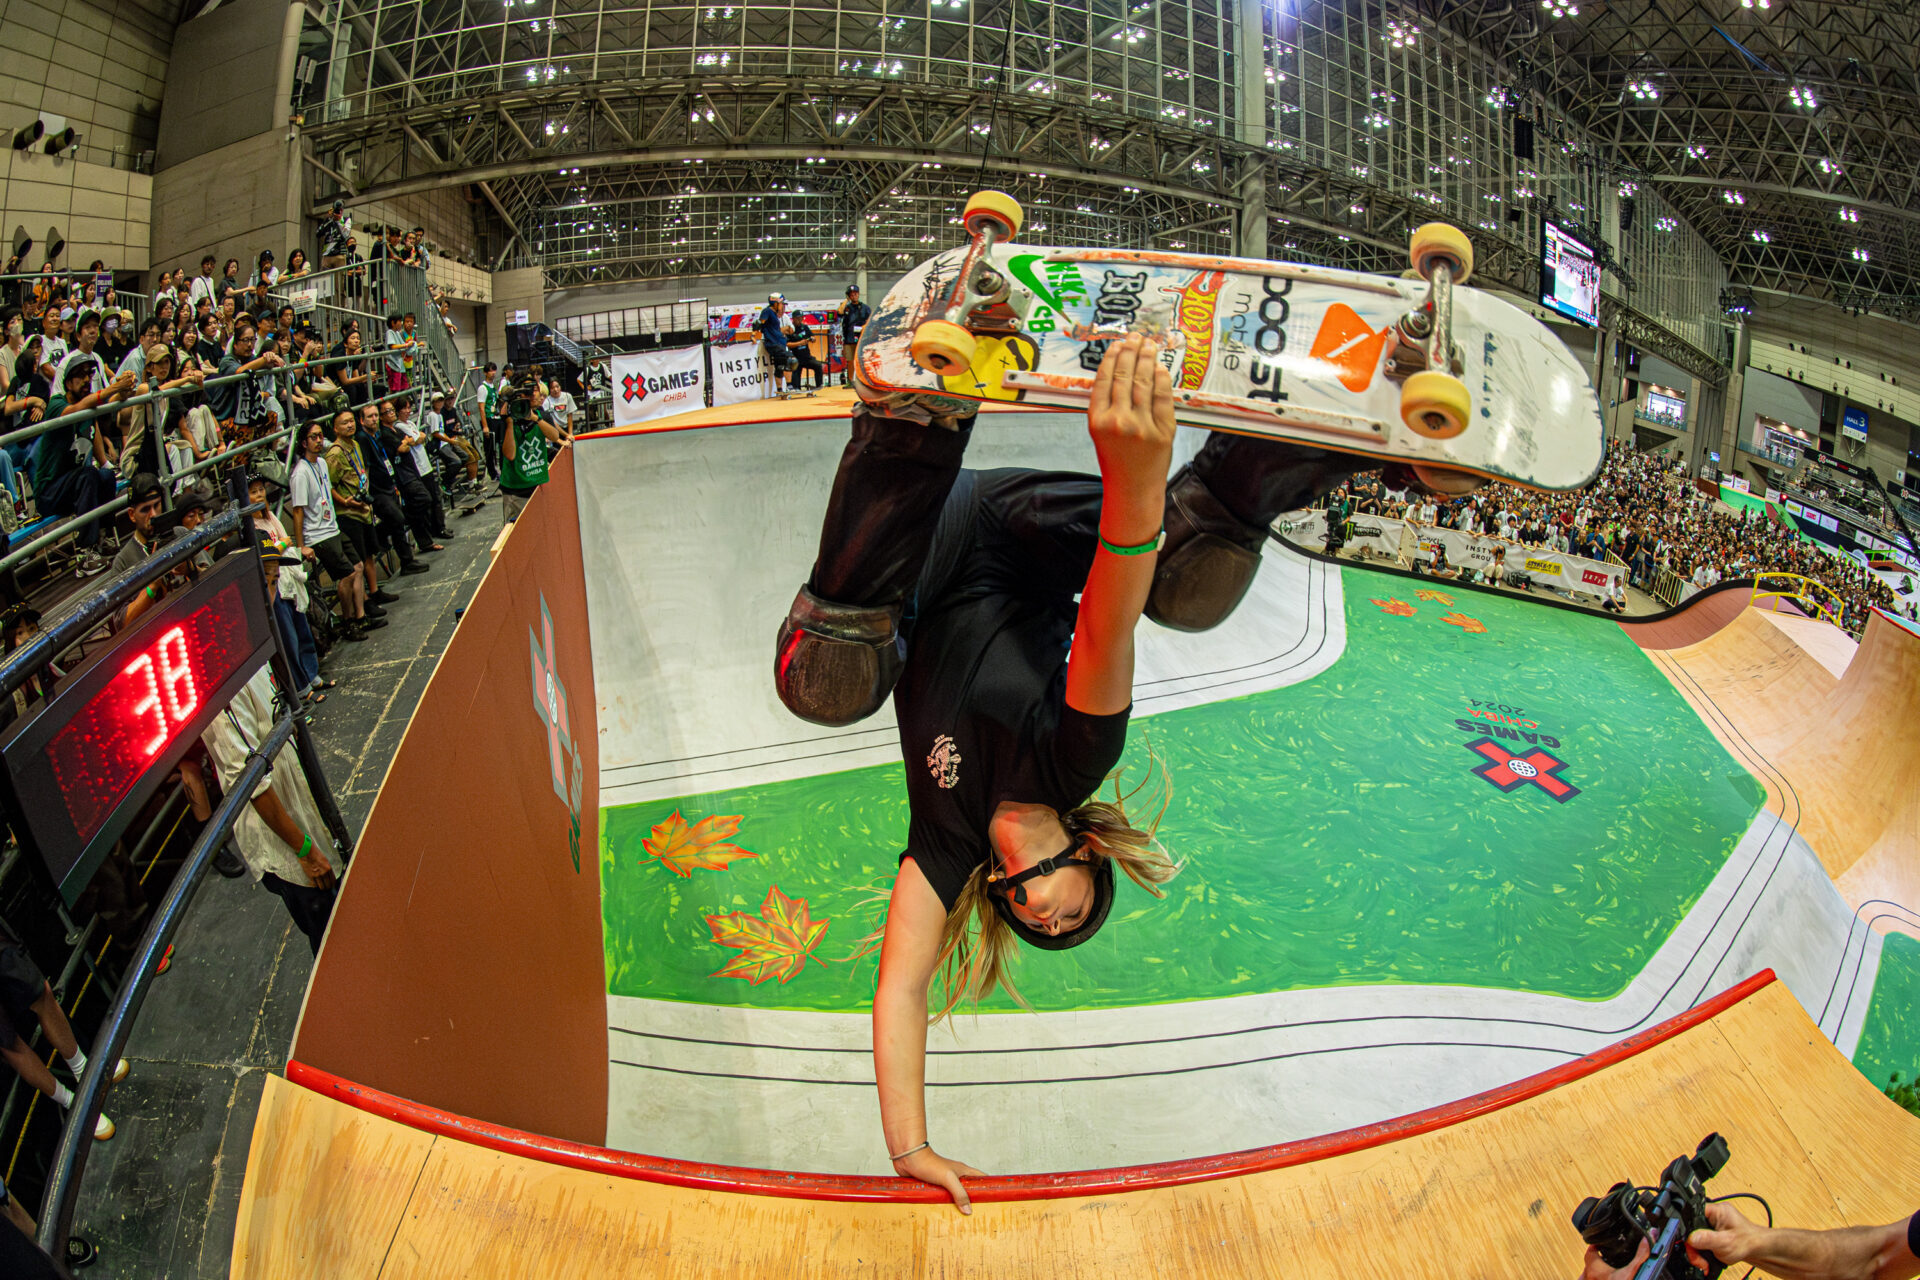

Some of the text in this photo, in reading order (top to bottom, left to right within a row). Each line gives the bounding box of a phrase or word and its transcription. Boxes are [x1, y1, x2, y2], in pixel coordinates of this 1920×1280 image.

[1042, 260, 1092, 307] NIKE
[719, 355, 775, 374] INSTYLE
[649, 369, 699, 394] GAMES
[732, 372, 769, 388] GROUP
[663, 392, 687, 403] CHIBA
[1466, 545, 1492, 555] INSTY
[1471, 553, 1491, 562] GROU
[123, 625, 198, 756] 38
[1470, 698, 1526, 717] 2024
[1465, 706, 1538, 729] CHIBA
[1454, 718, 1562, 749] GAMES
